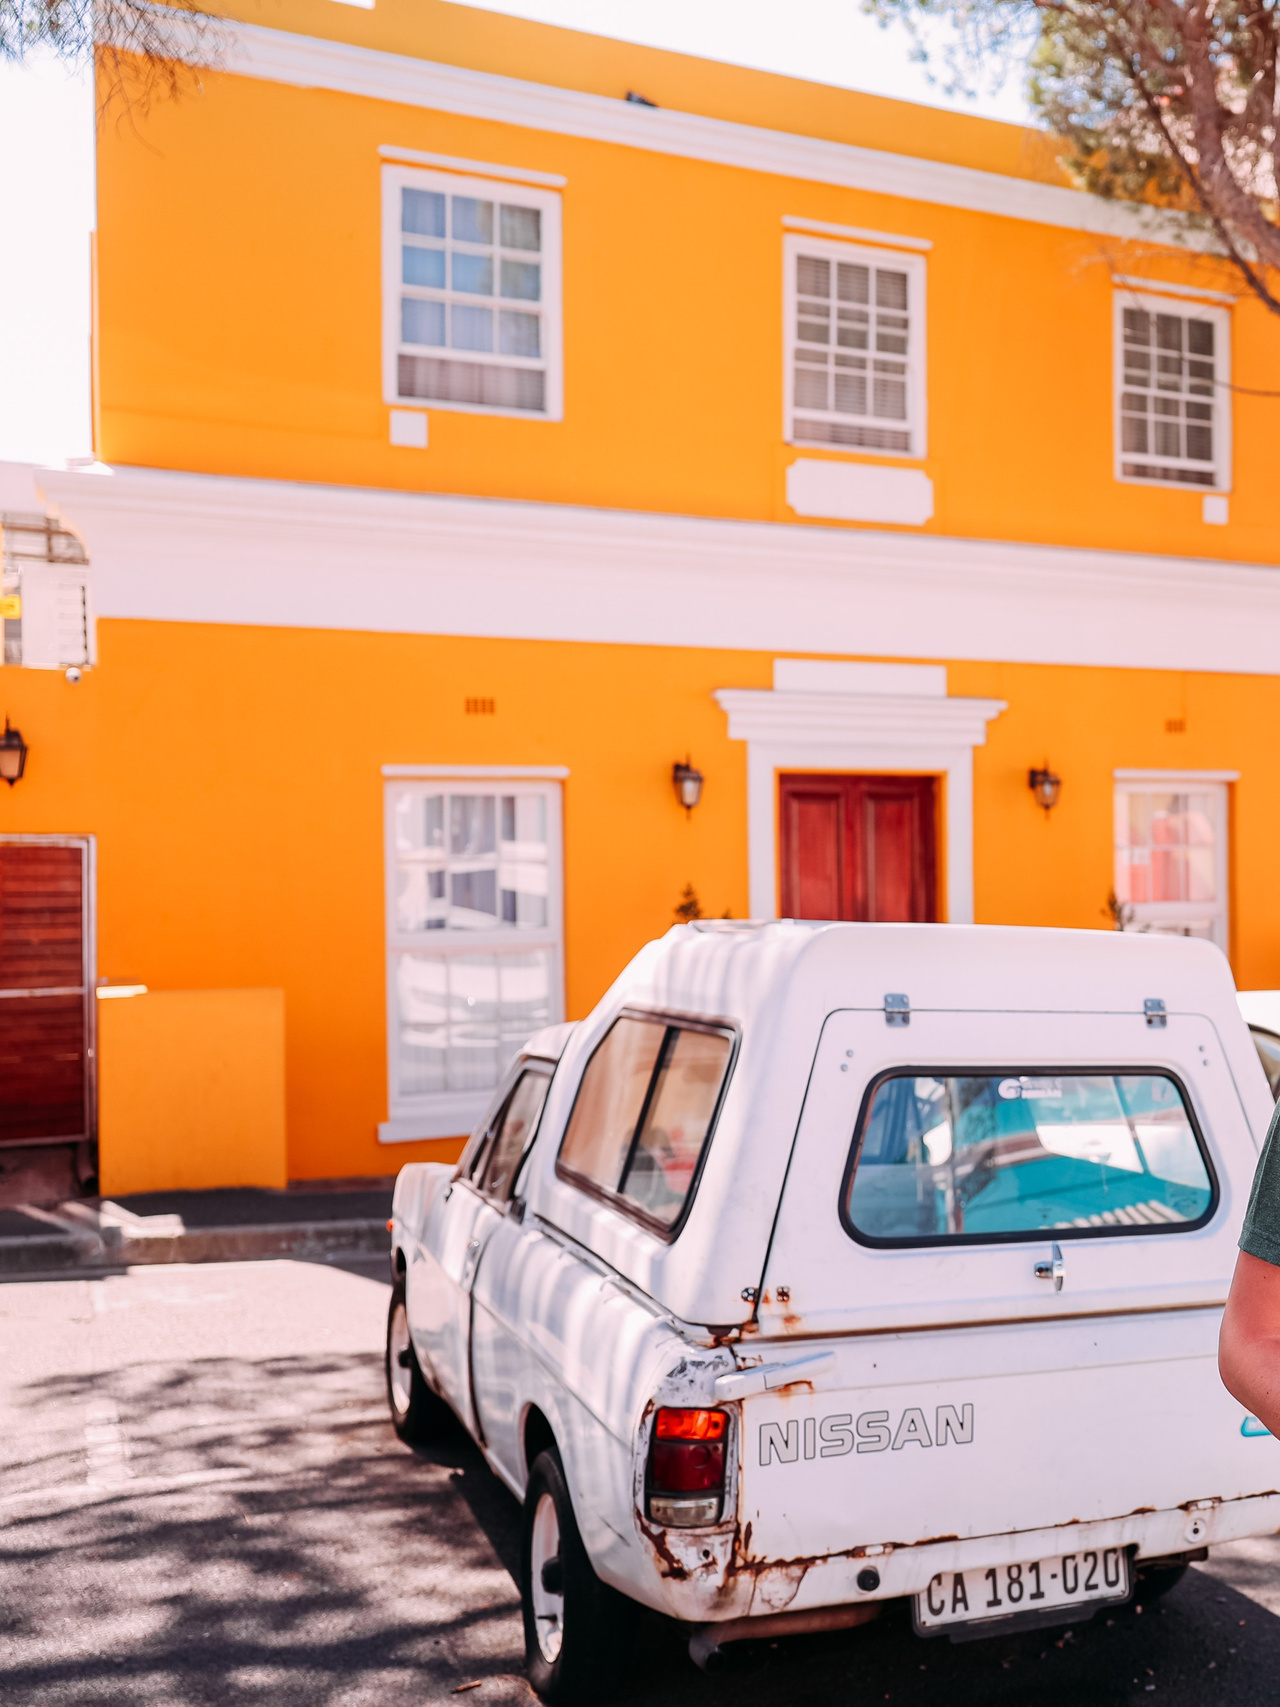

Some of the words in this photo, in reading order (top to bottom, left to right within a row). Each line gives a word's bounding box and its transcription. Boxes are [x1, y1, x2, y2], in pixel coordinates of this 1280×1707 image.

[759, 1403, 973, 1466] NISSAN
[927, 1572, 969, 1616] CA
[985, 1548, 1120, 1608] 181-020
